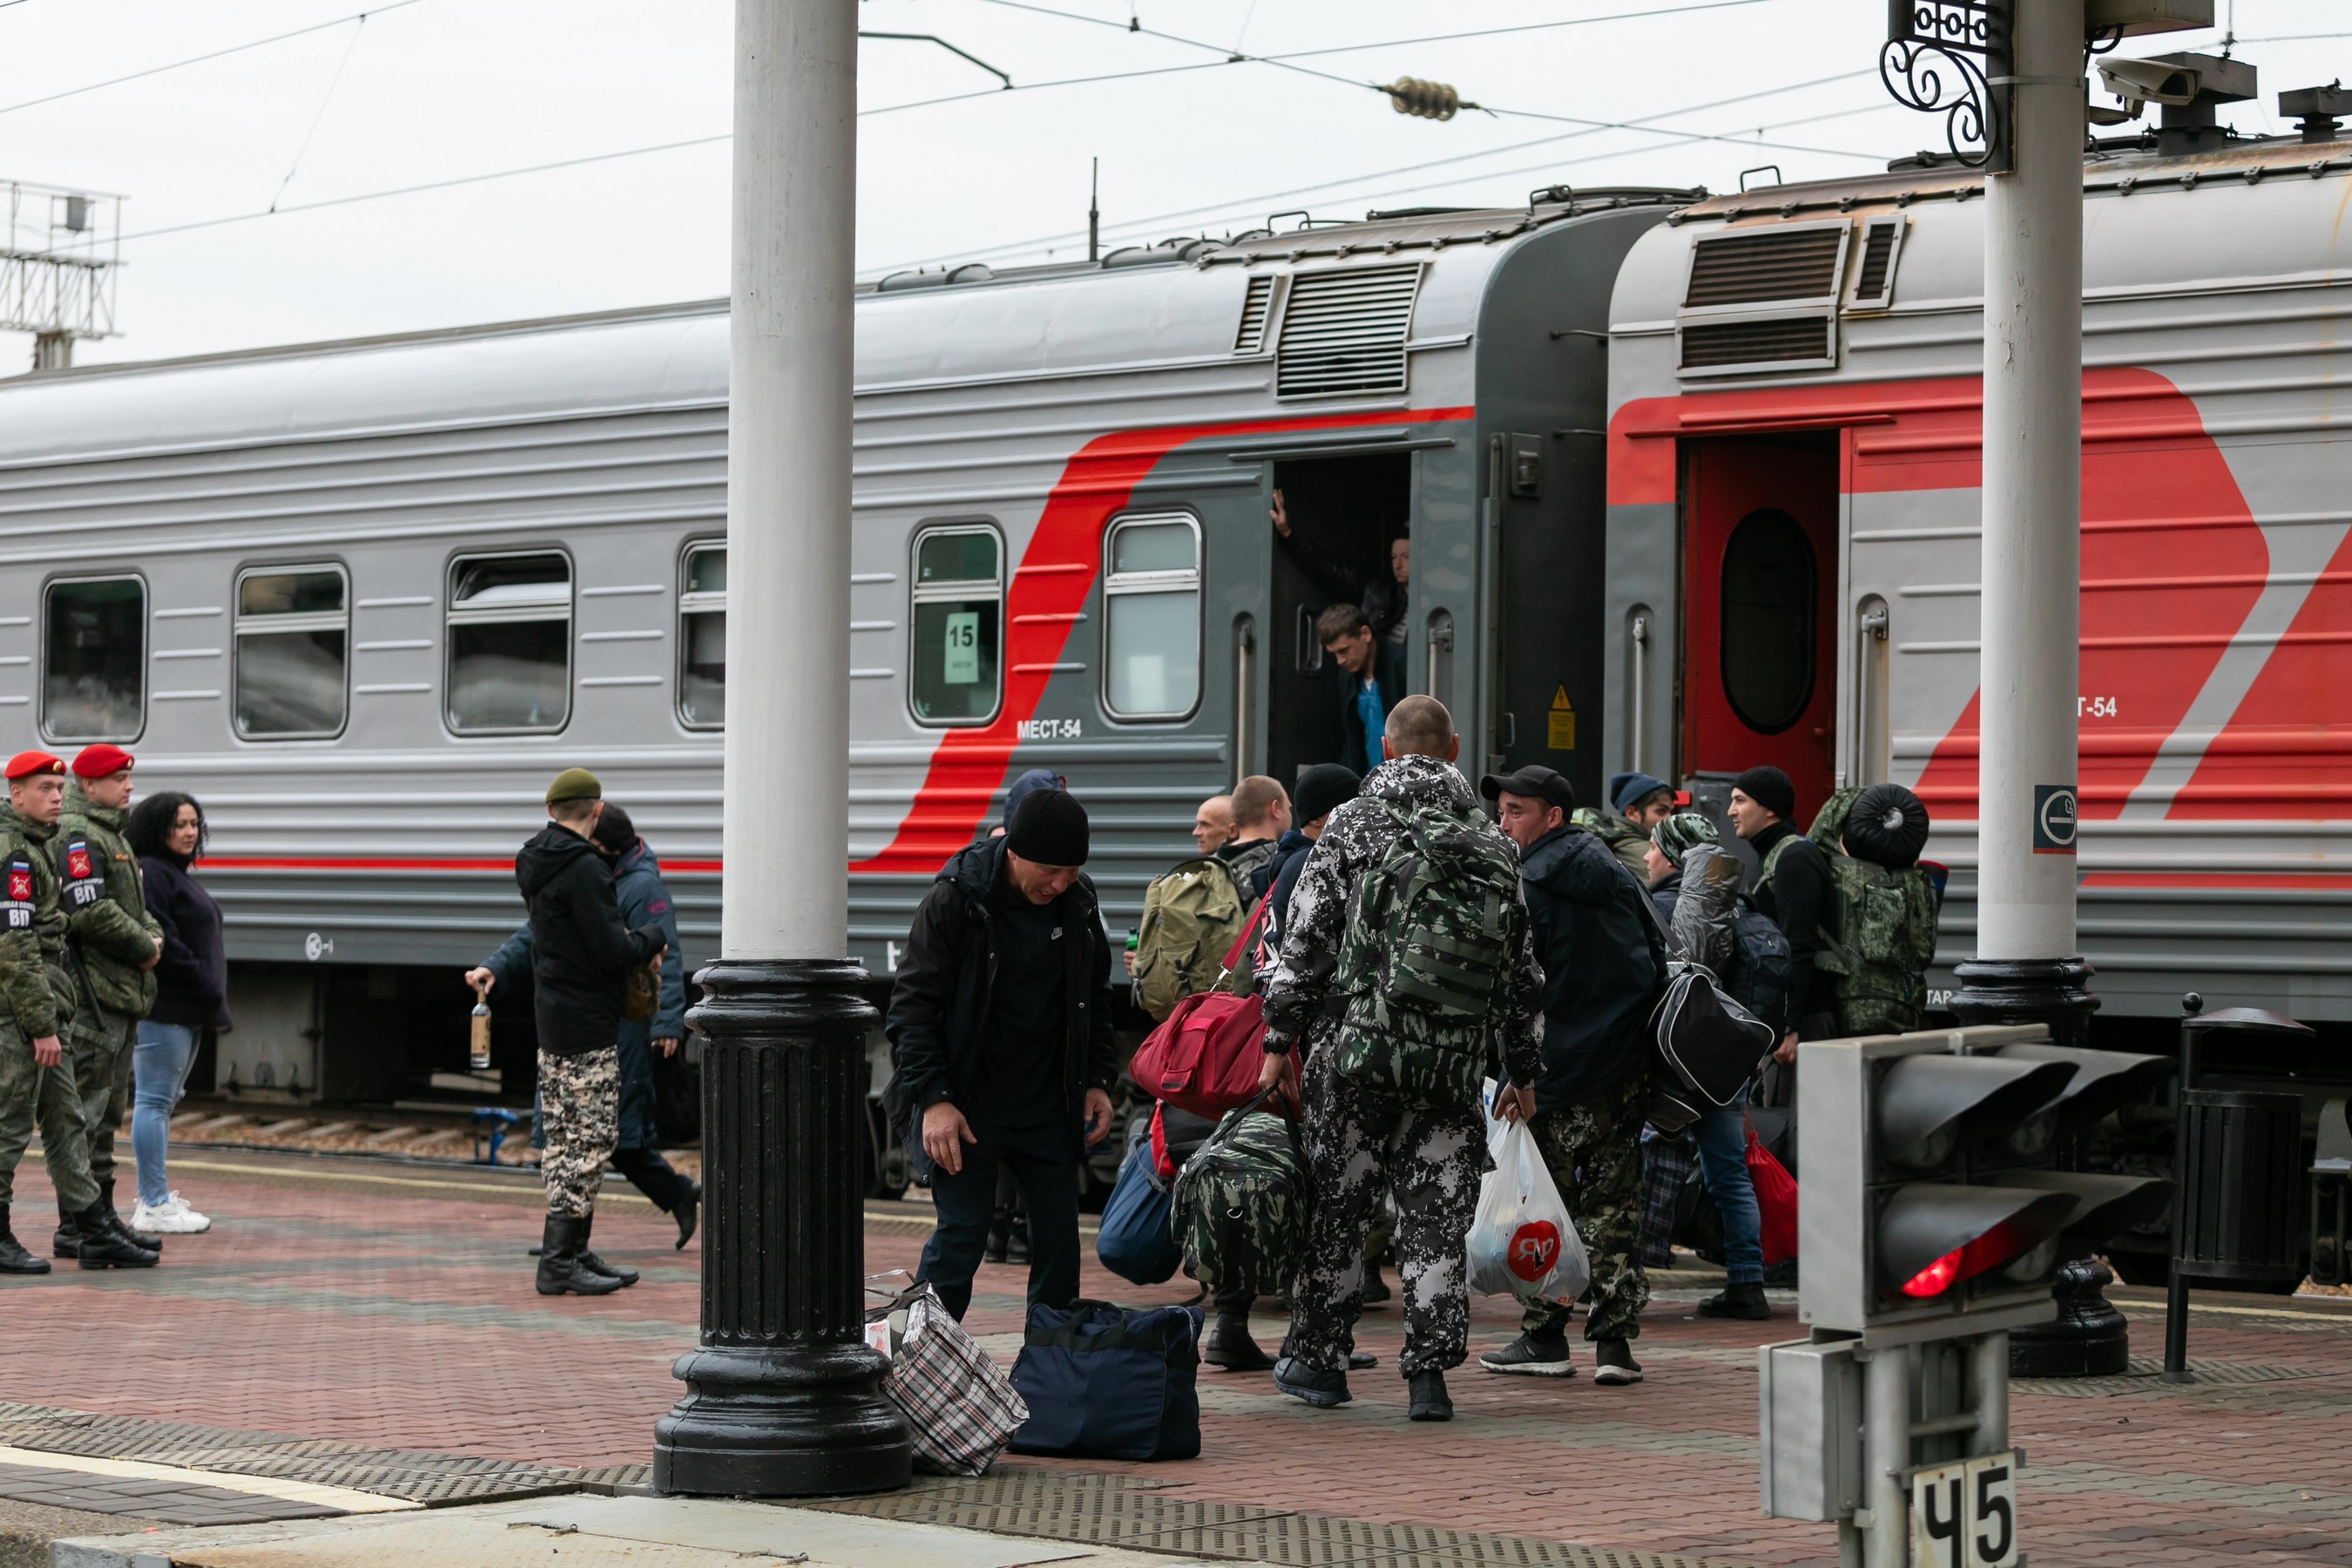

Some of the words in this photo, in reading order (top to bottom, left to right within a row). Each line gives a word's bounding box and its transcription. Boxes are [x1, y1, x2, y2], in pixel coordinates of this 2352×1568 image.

[950, 625, 973, 647] 15
[1017, 719, 1082, 739] МЕСТ-54
[73, 884, 98, 905] ВП
[9, 909, 30, 928] ВП
